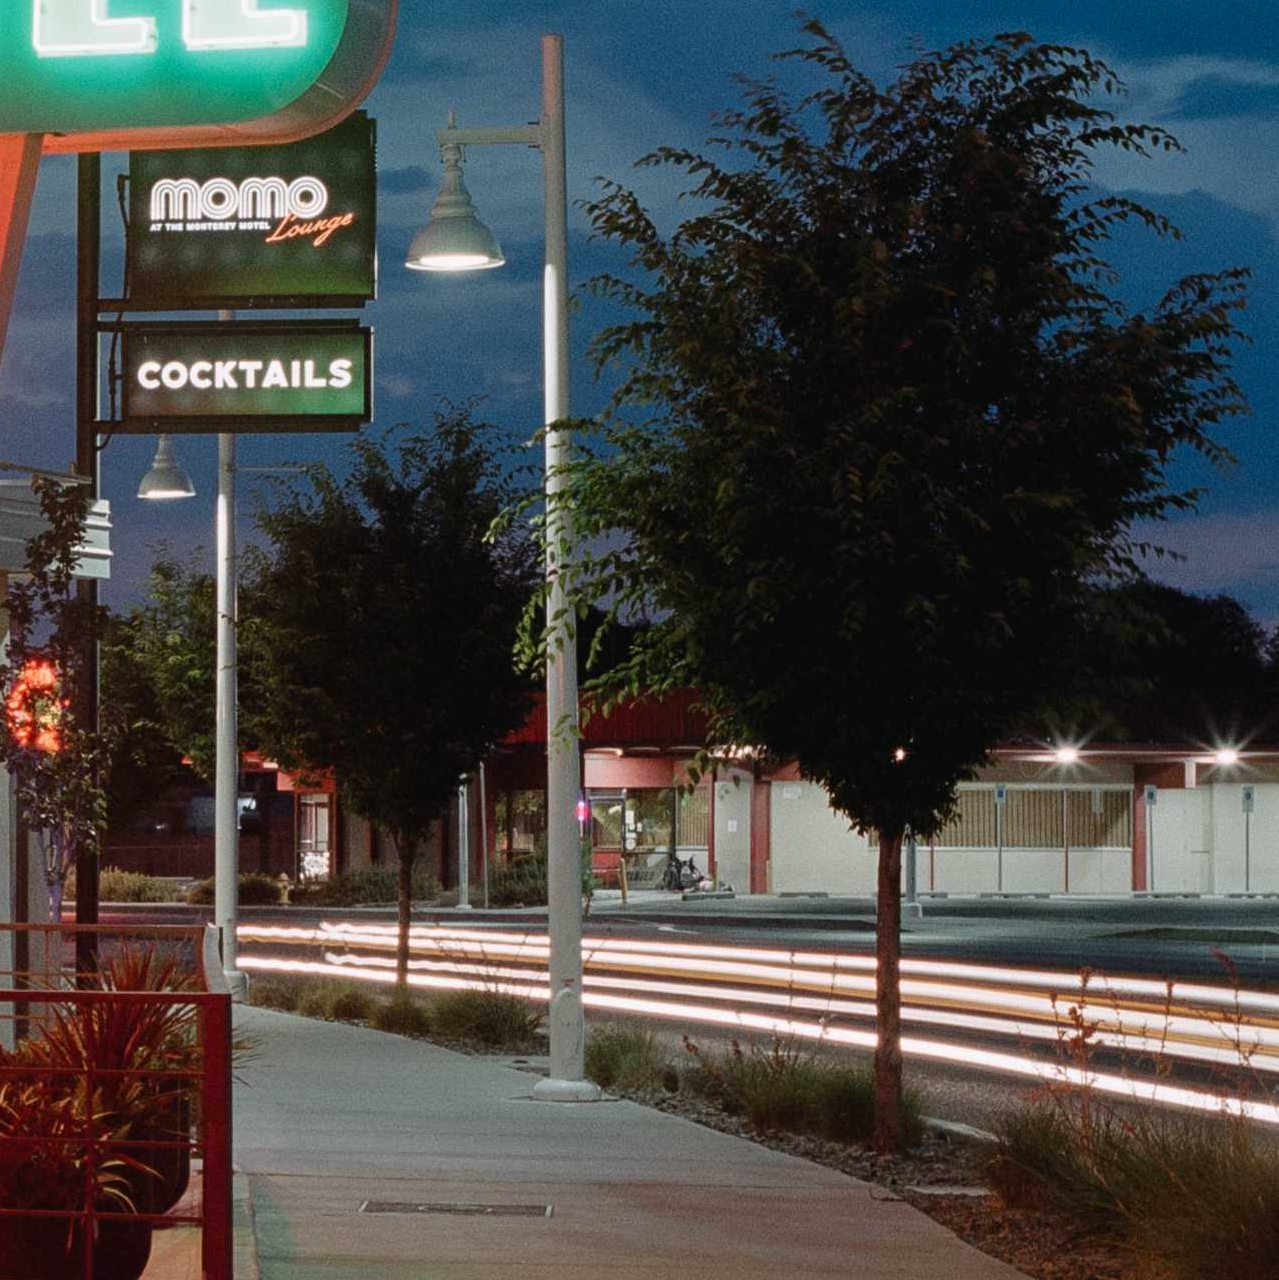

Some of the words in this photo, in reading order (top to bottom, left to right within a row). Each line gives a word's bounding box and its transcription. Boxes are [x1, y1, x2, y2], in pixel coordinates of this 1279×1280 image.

[150, 177, 328, 220] MOMO
[149, 223, 162, 232] AT
[165, 223, 184, 232] THE
[186, 222, 236, 231] MONTEREY
[238, 221, 271, 231] MOTEL
[265, 204, 354, 247] Lounge
[137, 358, 353, 389] COCKTAILS
